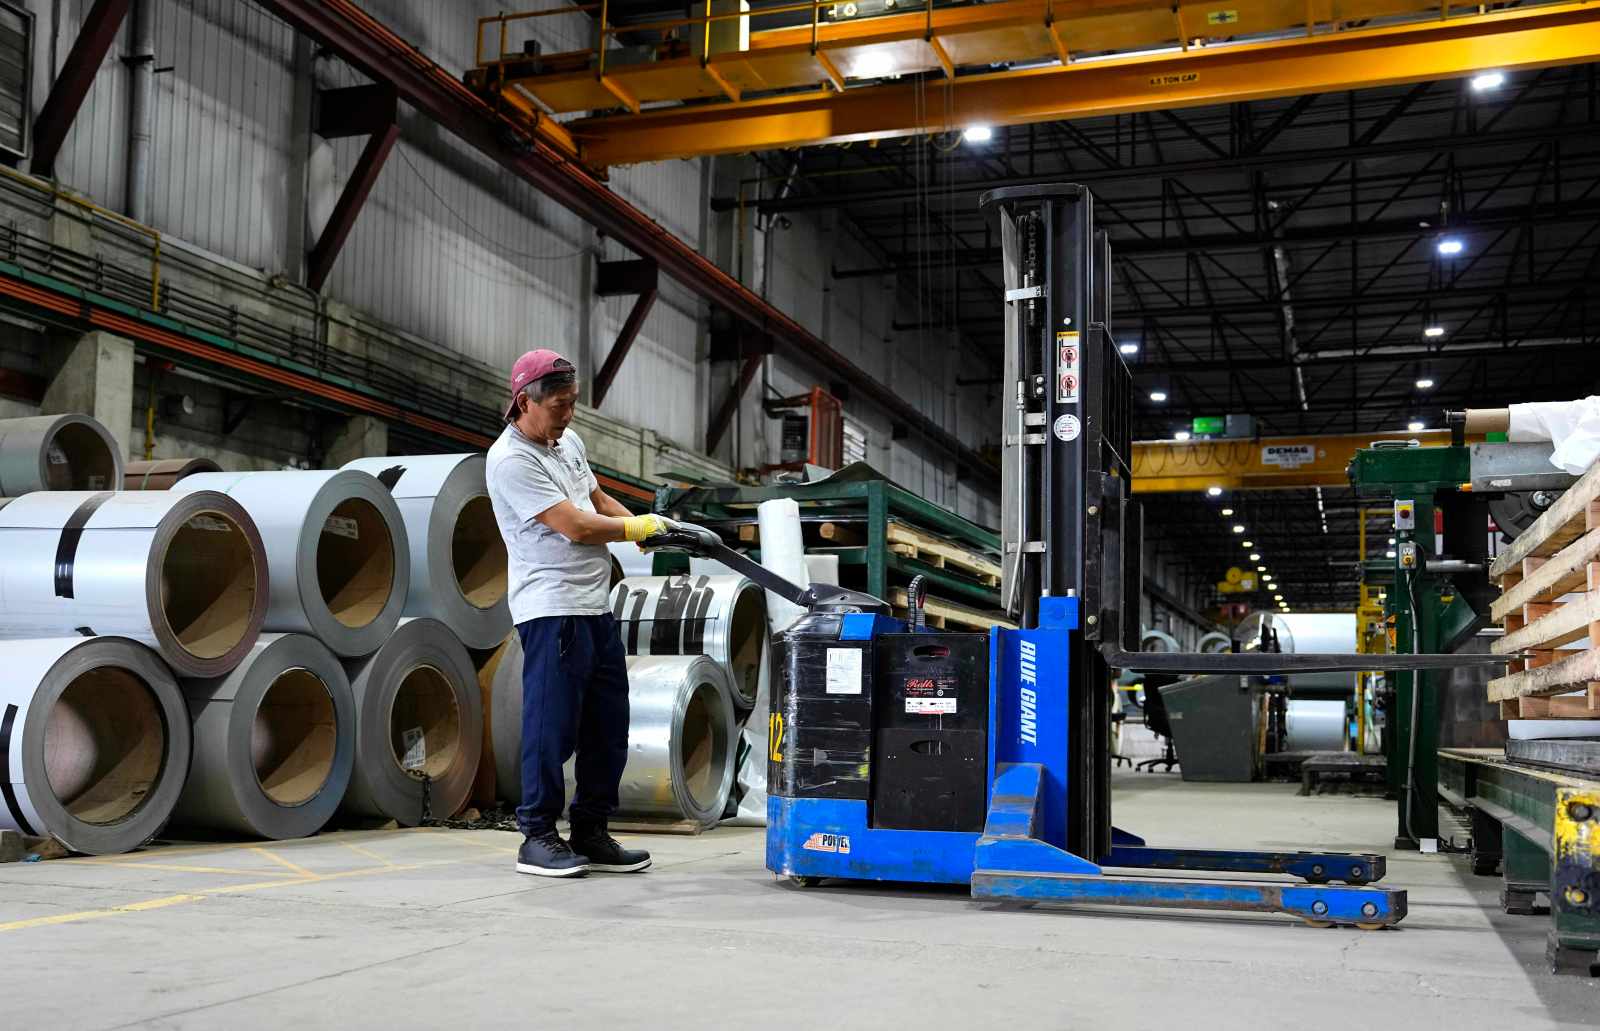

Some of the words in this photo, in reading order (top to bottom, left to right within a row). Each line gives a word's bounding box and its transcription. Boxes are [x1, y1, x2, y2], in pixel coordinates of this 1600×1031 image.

[1163, 75, 1180, 84] TON
[1181, 73, 1198, 82] CAP
[1267, 446, 1309, 455] DEMAG
[1020, 639, 1037, 687] BLUE
[769, 712, 784, 762] 12
[1020, 687, 1037, 747] GIANT
